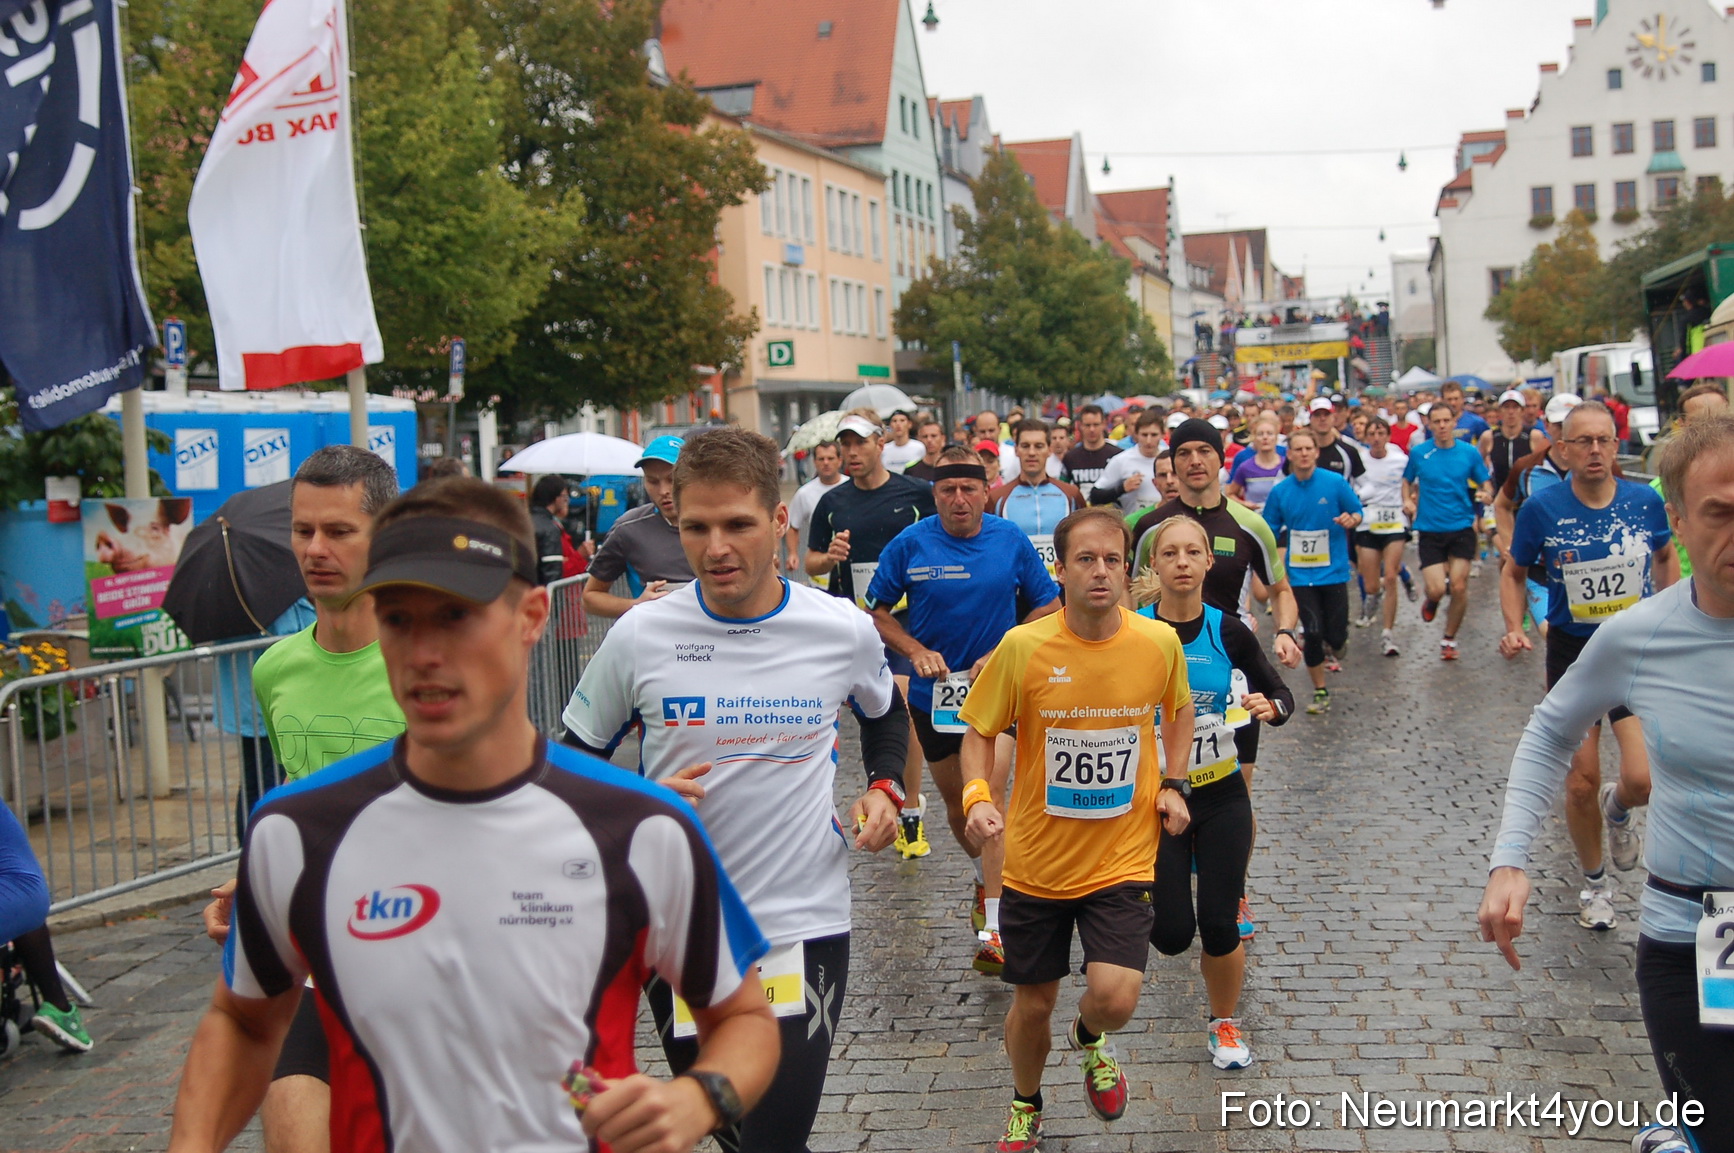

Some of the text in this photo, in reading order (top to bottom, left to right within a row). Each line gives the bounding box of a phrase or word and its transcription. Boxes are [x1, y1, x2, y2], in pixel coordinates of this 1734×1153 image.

[770, 343, 791, 364] D
[1377, 511, 1396, 522] 164
[1301, 540, 1317, 554] 87
[1580, 573, 1626, 601] 342
[1589, 603, 1623, 616] Markus
[675, 643, 715, 652] Wolfgang
[676, 653, 712, 662] Hofbeck
[716, 696, 823, 709] Raiffeisenbank
[716, 712, 822, 725] am Rothsee eG
[715, 733, 769, 746] kompetent
[776, 731, 798, 744] fair
[1047, 735, 1126, 749] PARTL Neumarkt
[1054, 748, 1133, 786] 2657
[1189, 770, 1216, 786] Lena
[1072, 793, 1116, 807] Robert
[512, 891, 544, 900] team
[354, 890, 414, 921] tkn
[520, 902, 574, 913] klinikum
[499, 914, 557, 928] nürnberg
